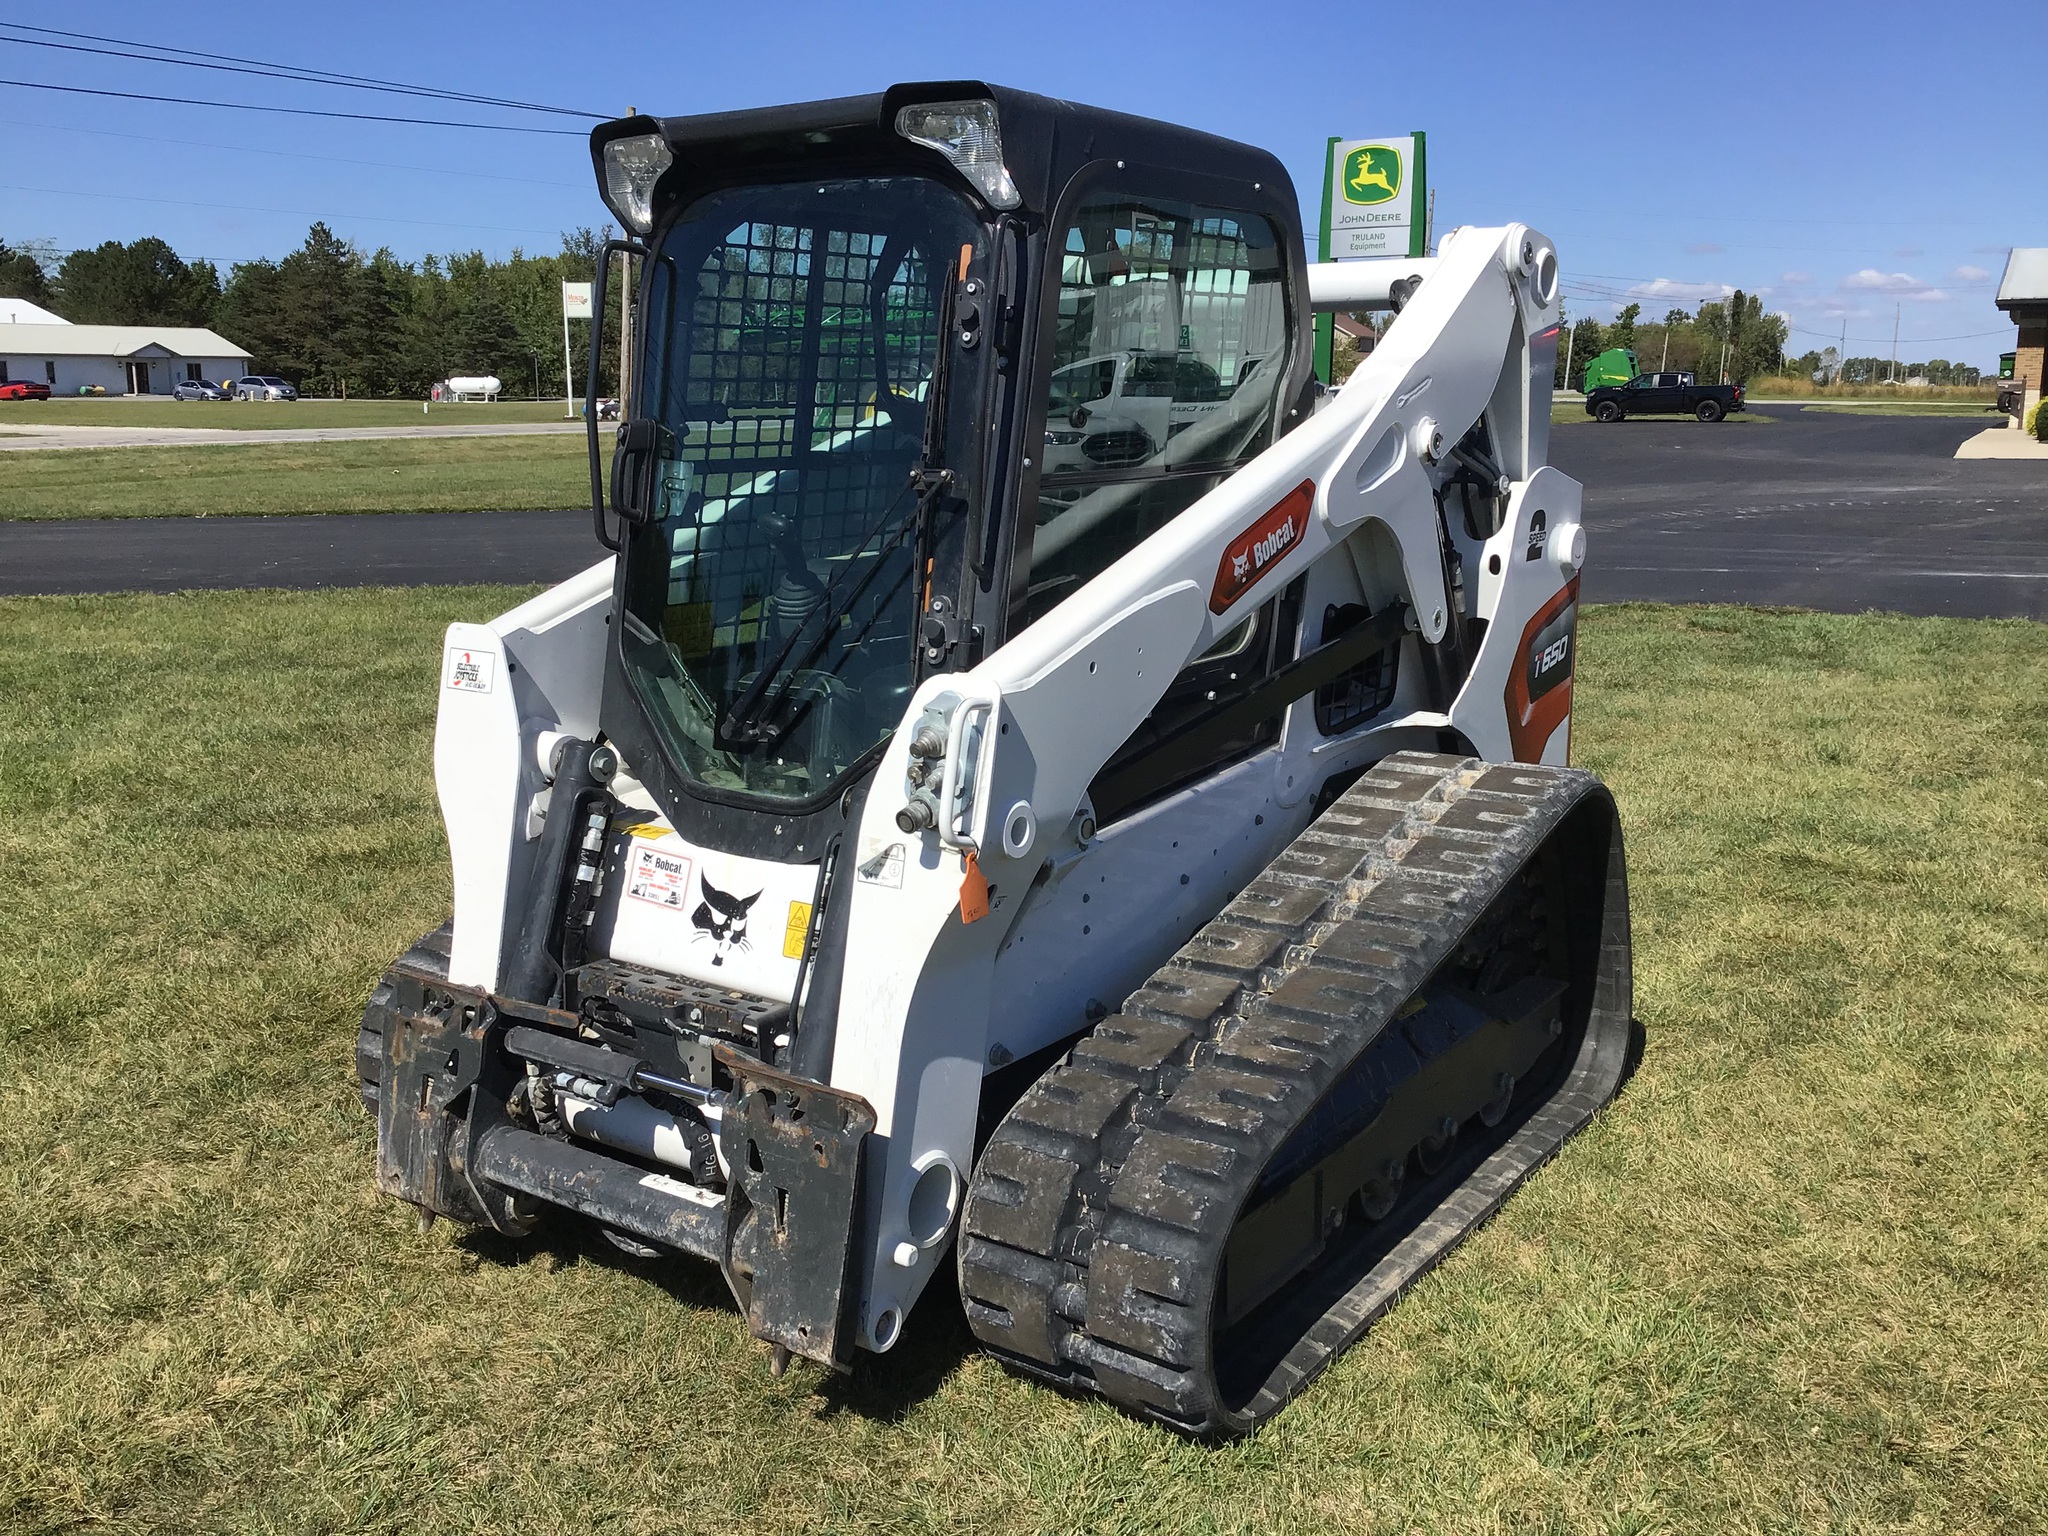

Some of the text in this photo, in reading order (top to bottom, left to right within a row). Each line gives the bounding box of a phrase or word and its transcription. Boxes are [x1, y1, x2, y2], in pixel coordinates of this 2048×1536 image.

[1339, 212, 1402, 224] JOHN DEERE
[1351, 233, 1385, 241] TRULAND
[1350, 242, 1386, 251] Equipment
[1253, 515, 1295, 568] Bobcat
[1527, 530, 1548, 545] SPEED
[1533, 634, 1569, 679] T650
[654, 857, 682, 875] Bobcat
